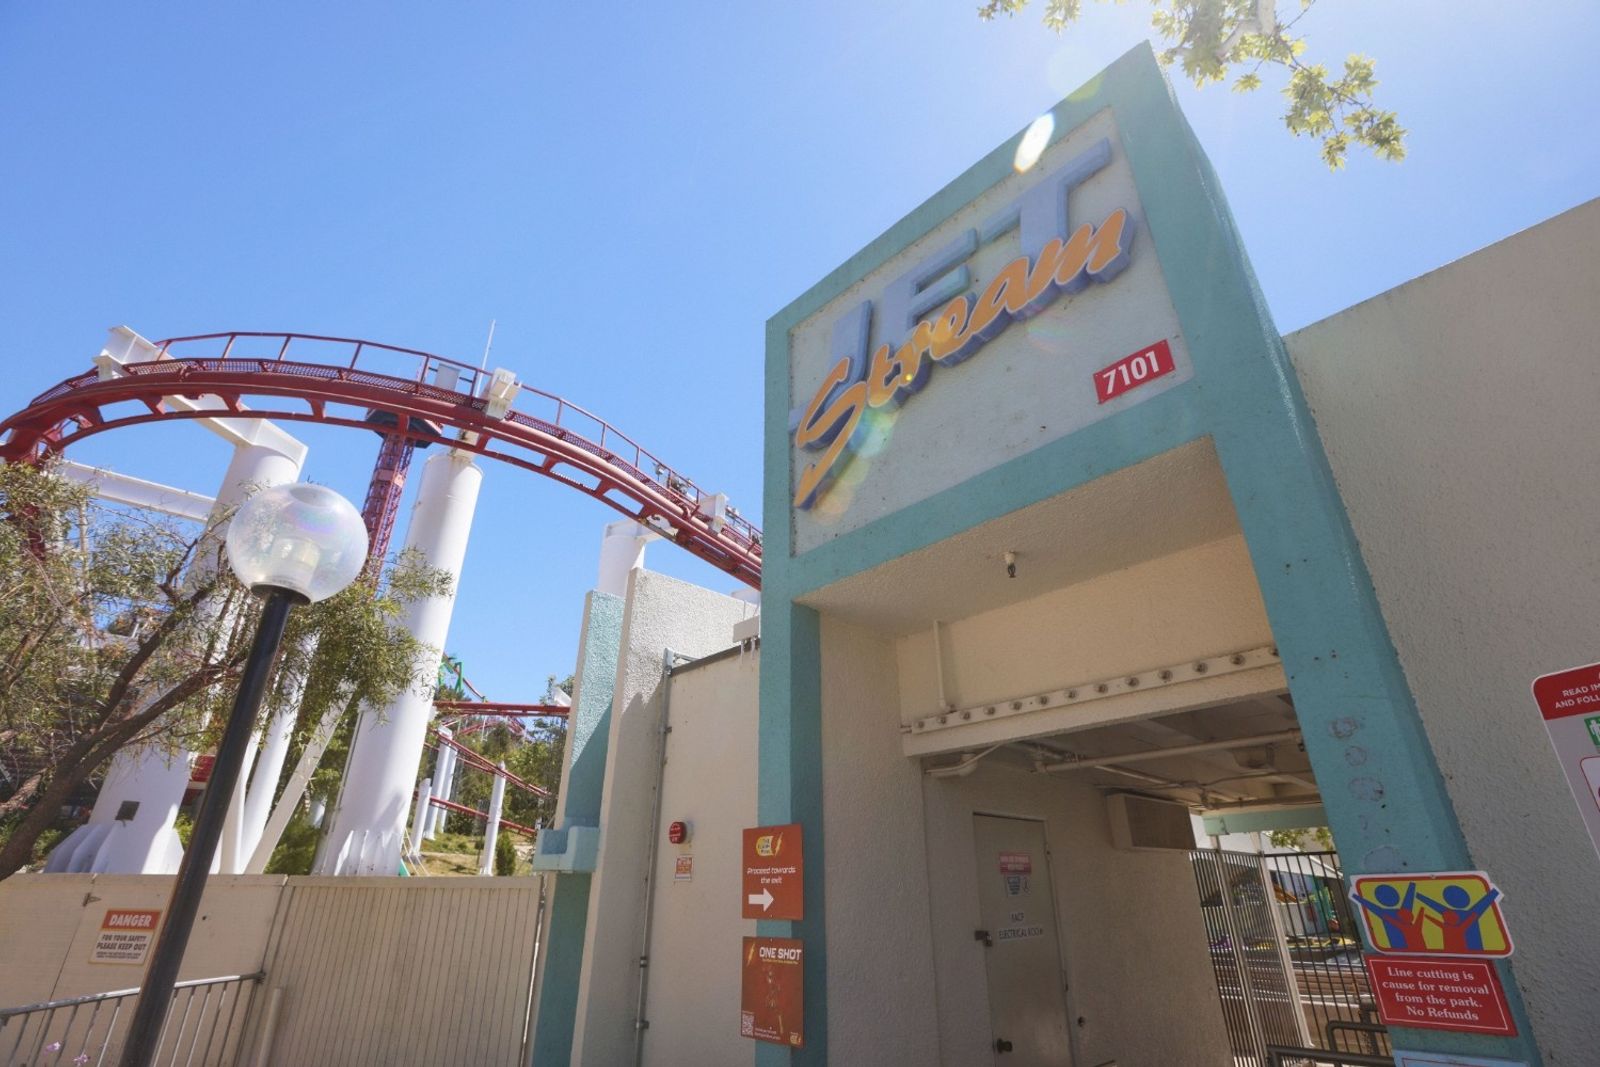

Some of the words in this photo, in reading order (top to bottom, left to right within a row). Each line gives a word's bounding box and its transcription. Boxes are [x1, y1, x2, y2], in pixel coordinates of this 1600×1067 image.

[794, 208, 1130, 510] Stream
[1103, 351, 1160, 394] 7101
[1562, 686, 1589, 697] READ
[1555, 699, 1575, 709] AND
[108, 914, 153, 927] DANGER
[128, 934, 147, 942] SAFETY
[96, 942, 118, 950] PLEASE
[133, 943, 147, 951] OUT
[759, 946, 776, 959] ONE
[777, 947, 802, 961] SHOT
[1387, 966, 1413, 978] Line
[1416, 969, 1460, 982] cutting
[1462, 970, 1475, 981] is
[1382, 981, 1416, 991] cause
[1418, 981, 1436, 992] for
[1439, 982, 1489, 995] removal
[1395, 992, 1423, 1004] from
[1426, 993, 1446, 1006] the
[1449, 996, 1483, 1009] park.
[1406, 1005, 1425, 1017] No
[1428, 1006, 1479, 1021] Refunds
